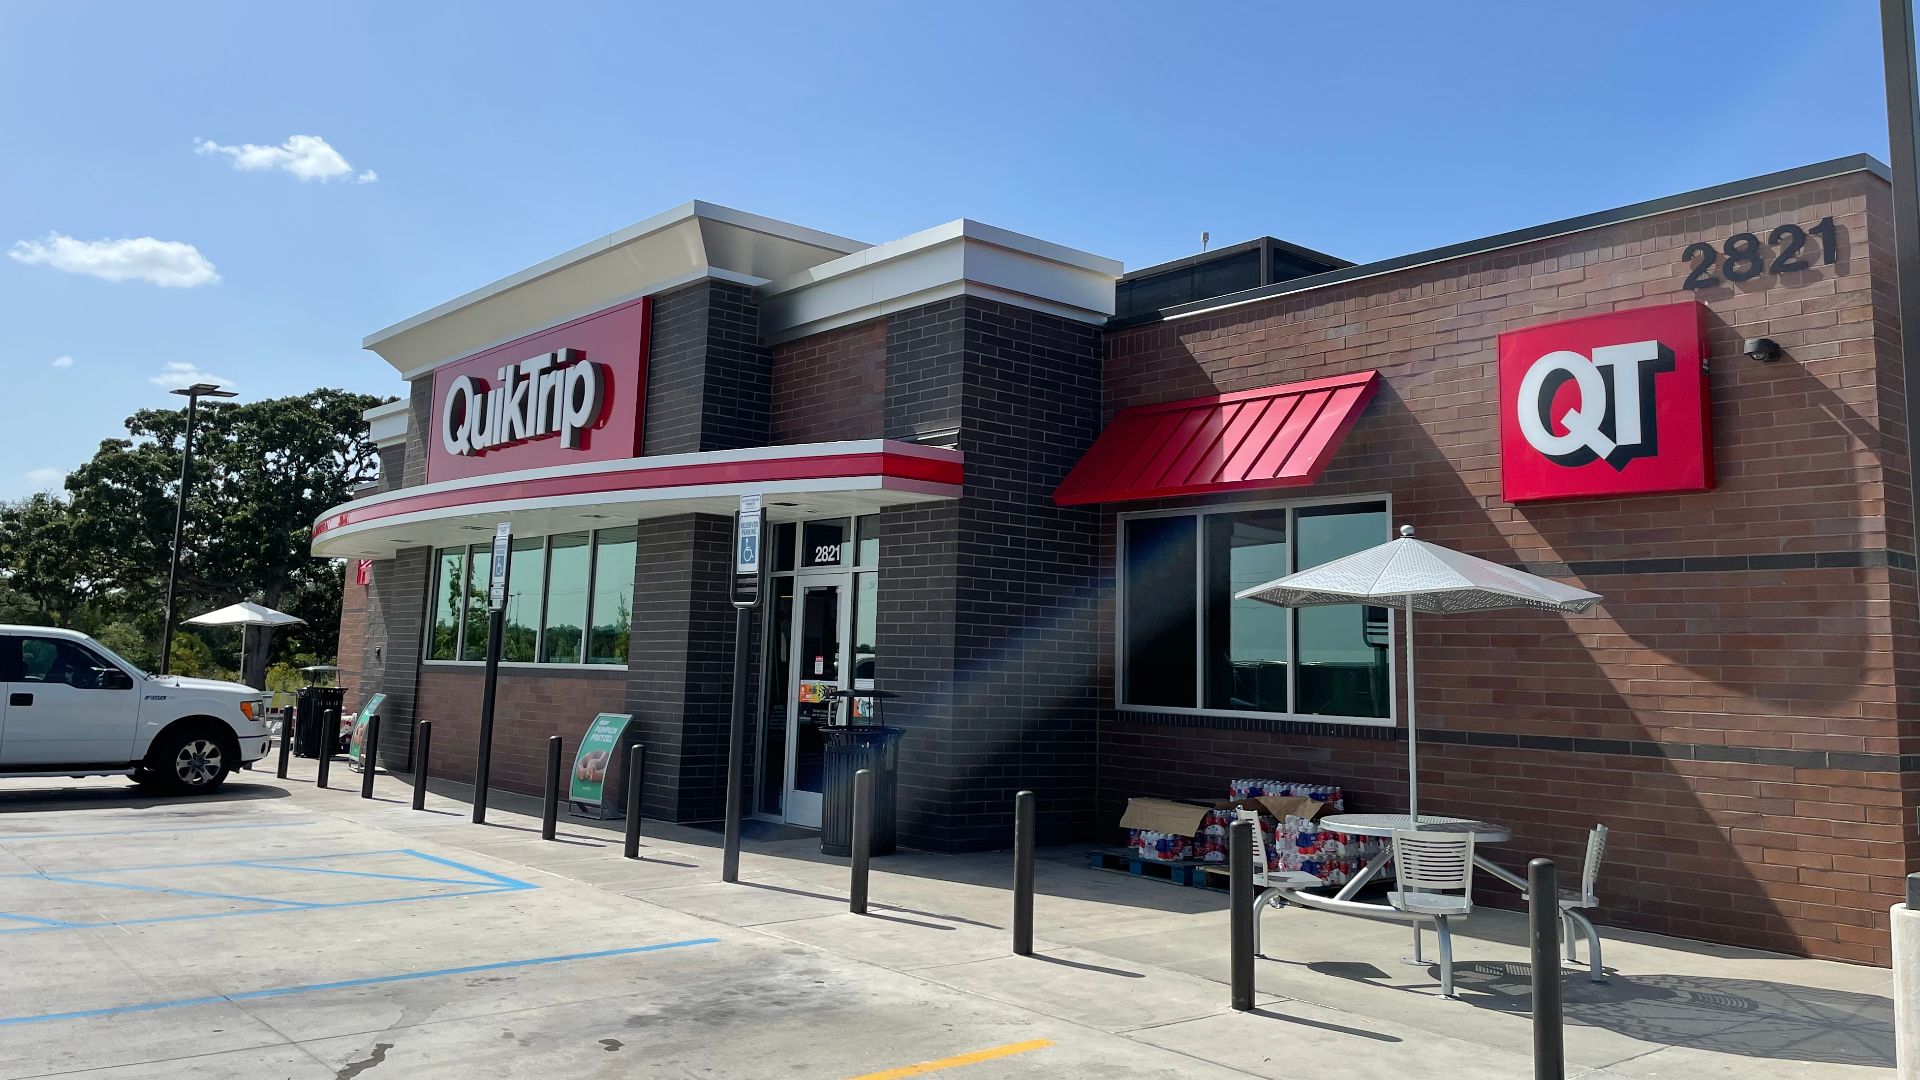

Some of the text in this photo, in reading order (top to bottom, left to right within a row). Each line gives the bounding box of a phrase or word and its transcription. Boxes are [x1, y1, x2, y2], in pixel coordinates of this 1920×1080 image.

[1682, 216, 1837, 291] 2821
[443, 347, 600, 457] QuikTrip
[1517, 339, 1662, 462] QT
[814, 544, 841, 563] 2821
